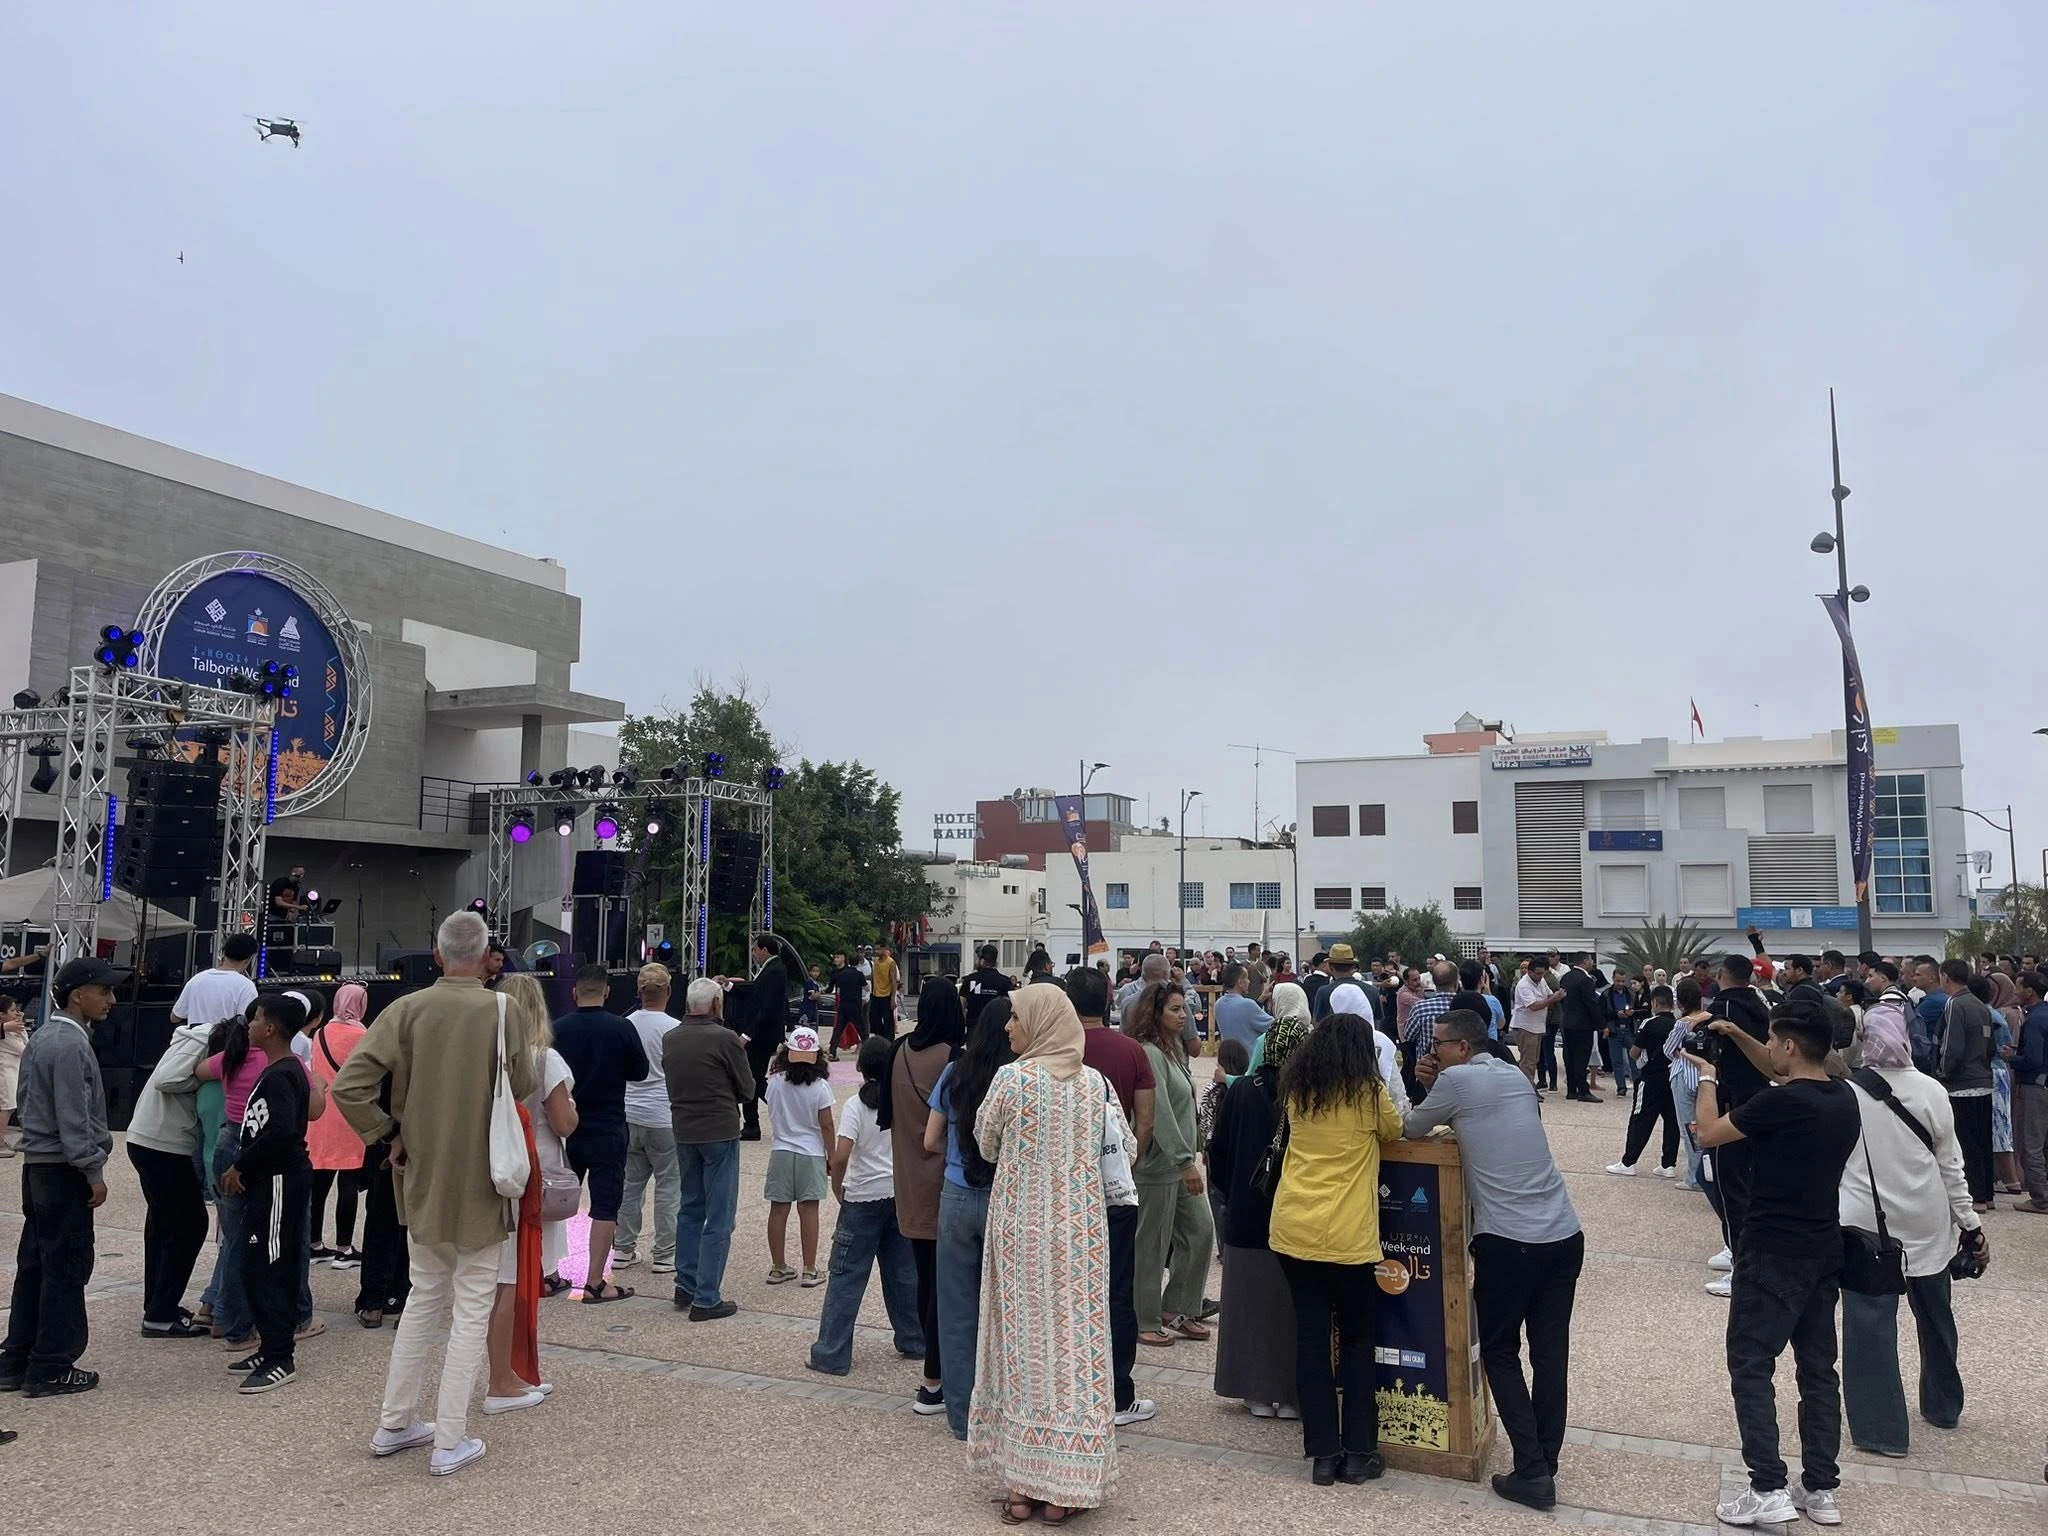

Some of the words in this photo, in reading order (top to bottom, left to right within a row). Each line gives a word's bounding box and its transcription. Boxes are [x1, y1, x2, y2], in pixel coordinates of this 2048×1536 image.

[934, 813, 985, 824] HOTEL
[933, 828, 985, 839] BAHIA
[1380, 1240, 1431, 1255] Week-end
